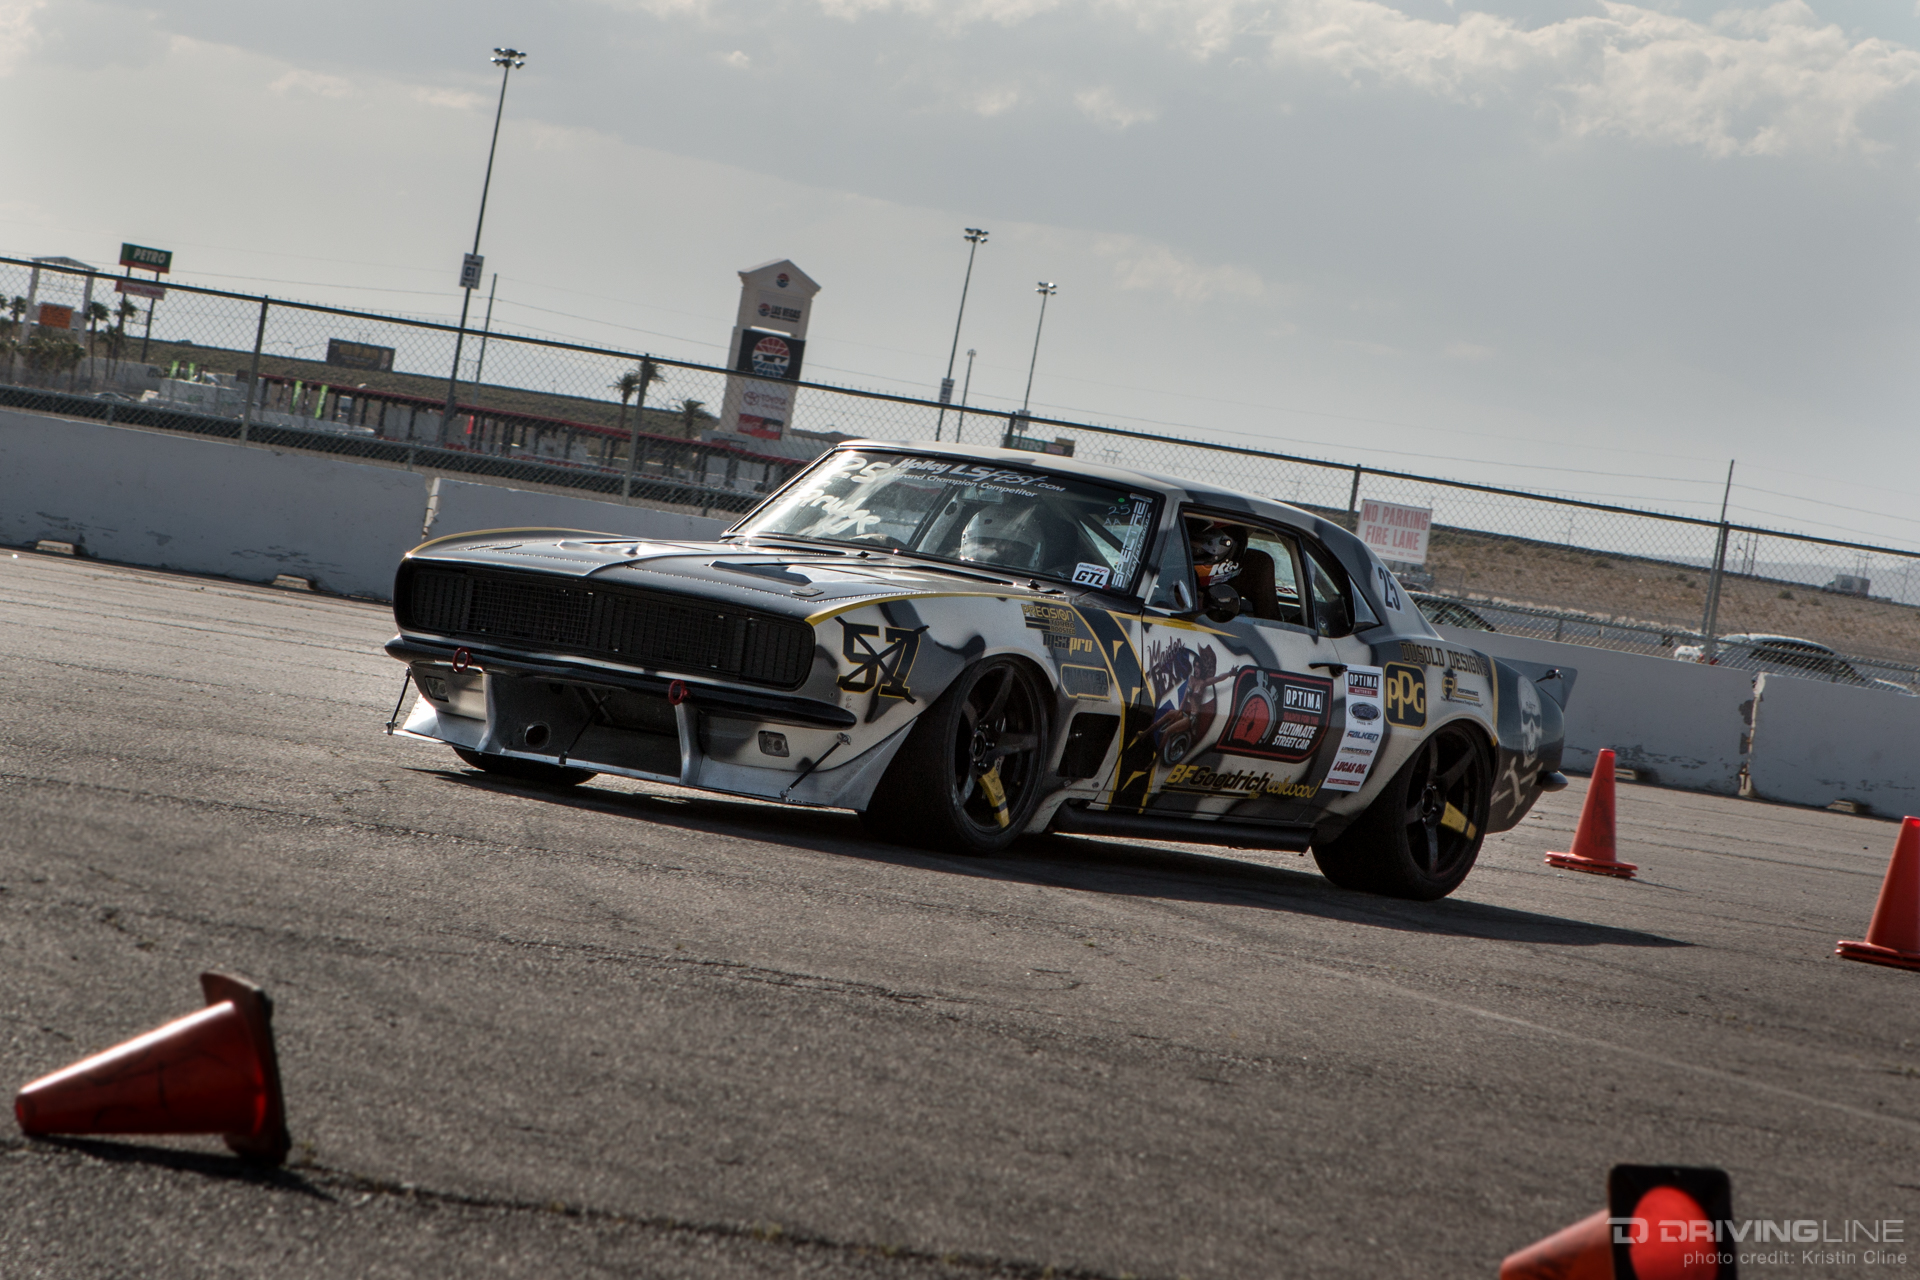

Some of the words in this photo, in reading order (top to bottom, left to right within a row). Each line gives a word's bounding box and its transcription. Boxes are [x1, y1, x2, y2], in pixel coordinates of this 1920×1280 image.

[133, 247, 166, 264] PETRO
[895, 459, 952, 475] Holley
[892, 473, 926, 481] Grand
[927, 475, 978, 488] Champion
[980, 482, 1039, 498] Competitor
[1108, 504, 1131, 515] 25
[1362, 503, 1379, 523] NO
[1381, 505, 1429, 531] PARKING
[1364, 524, 1390, 546] FIRE
[1392, 528, 1421, 551] LANE
[1074, 570, 1107, 586] GTL
[1377, 566, 1401, 612] 25
[1050, 626, 1076, 635] BOOSTED
[1399, 642, 1445, 668] DUSOLD
[1446, 648, 1490, 678] DESIGNS
[1349, 673, 1379, 688] OPTIMA
[1285, 689, 1321, 710] OPTIMA
[1386, 669, 1425, 720] PPG
[1278, 721, 1317, 739] ULTIMATE
[1347, 730, 1379, 741] FALKEN
[1272, 735, 1296, 749] STREET
[1295, 738, 1311, 750] CAR
[1333, 760, 1357, 774] LUCAS
[1354, 763, 1368, 774] OIL
[1165, 764, 1271, 792] BFGoodrich
[1266, 773, 1323, 799] wilwood
